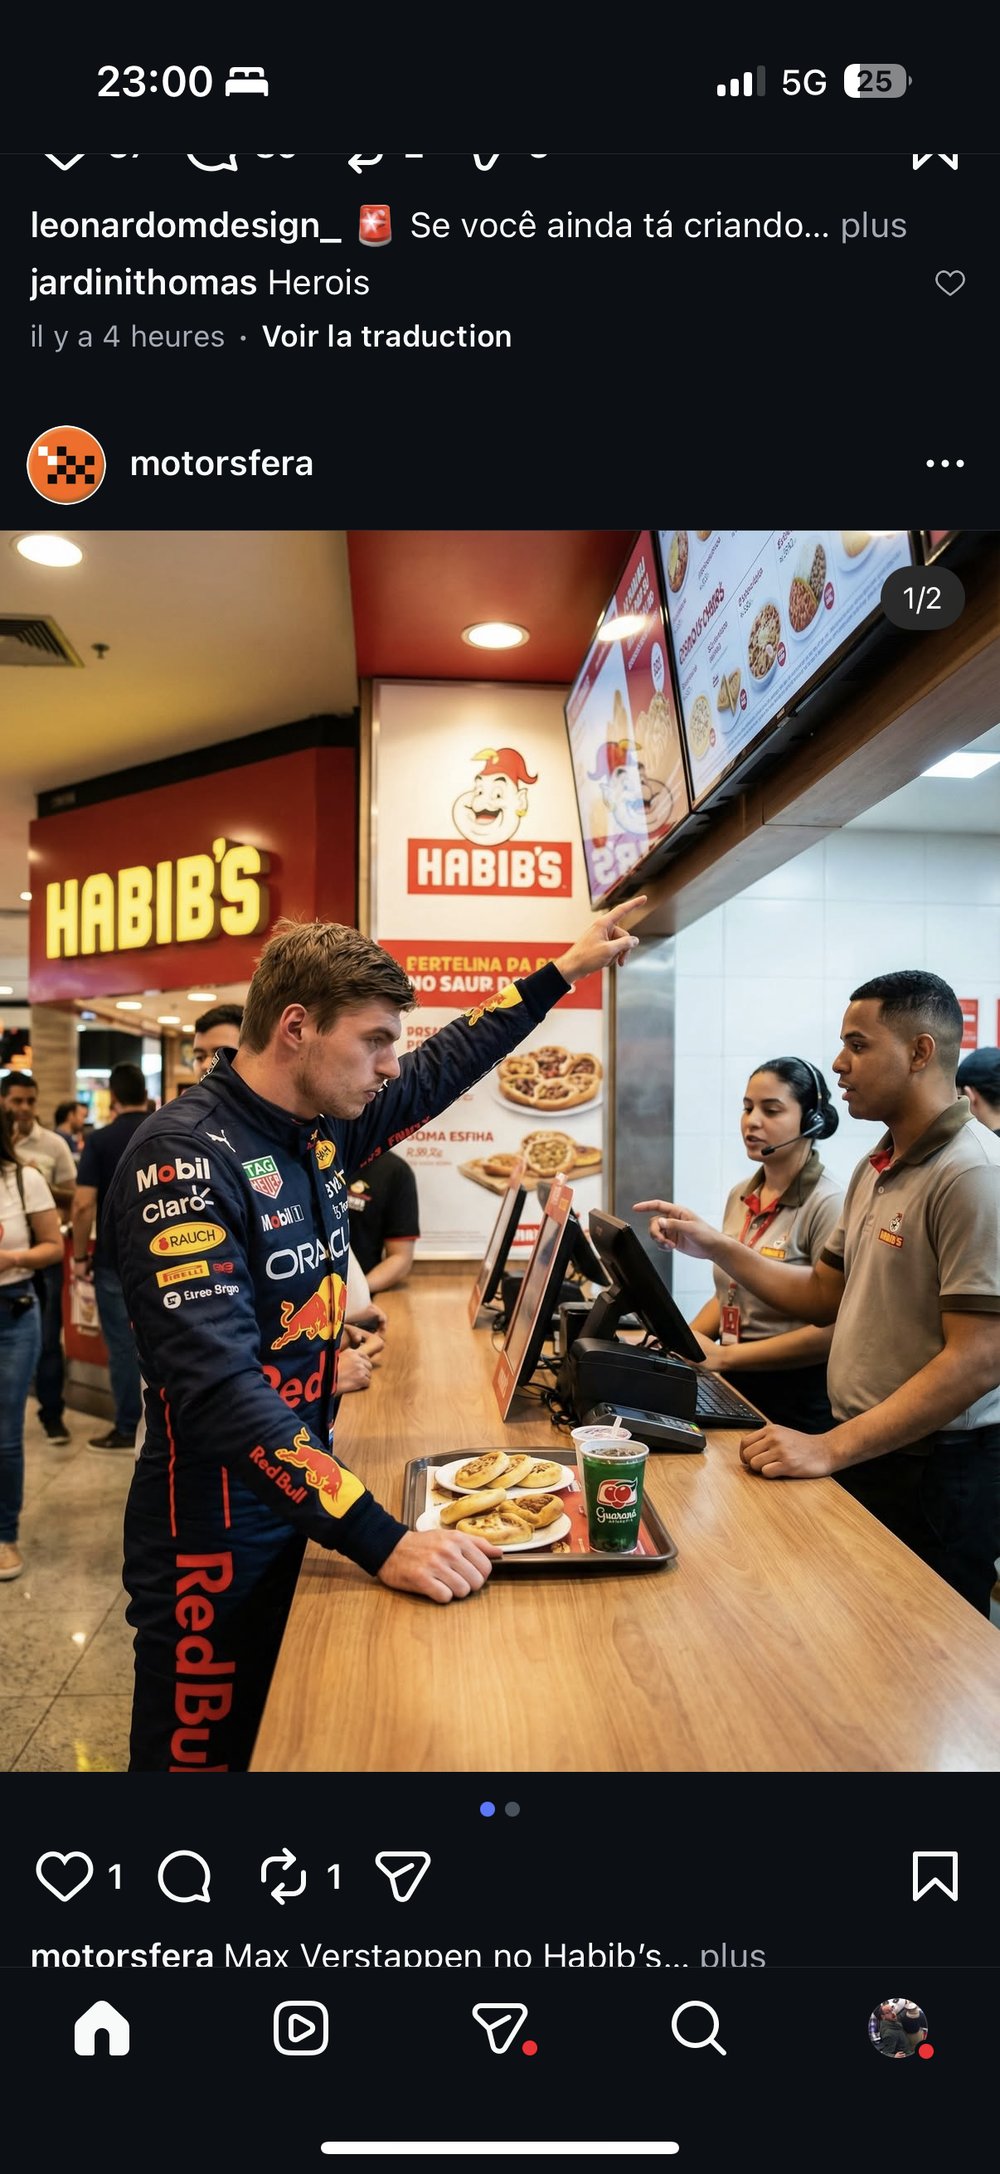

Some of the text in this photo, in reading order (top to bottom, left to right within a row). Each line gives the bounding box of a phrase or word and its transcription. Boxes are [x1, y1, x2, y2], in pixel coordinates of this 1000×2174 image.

[417, 845, 563, 890] HABIB'S
[46, 836, 262, 959] HABIB'S
[136, 1157, 211, 1193] Mobil
[244, 1159, 275, 1180] TAG
[142, 1193, 208, 1225] Claro
[261, 1209, 293, 1232] Mobil
[169, 1229, 217, 1248] RAUCH
